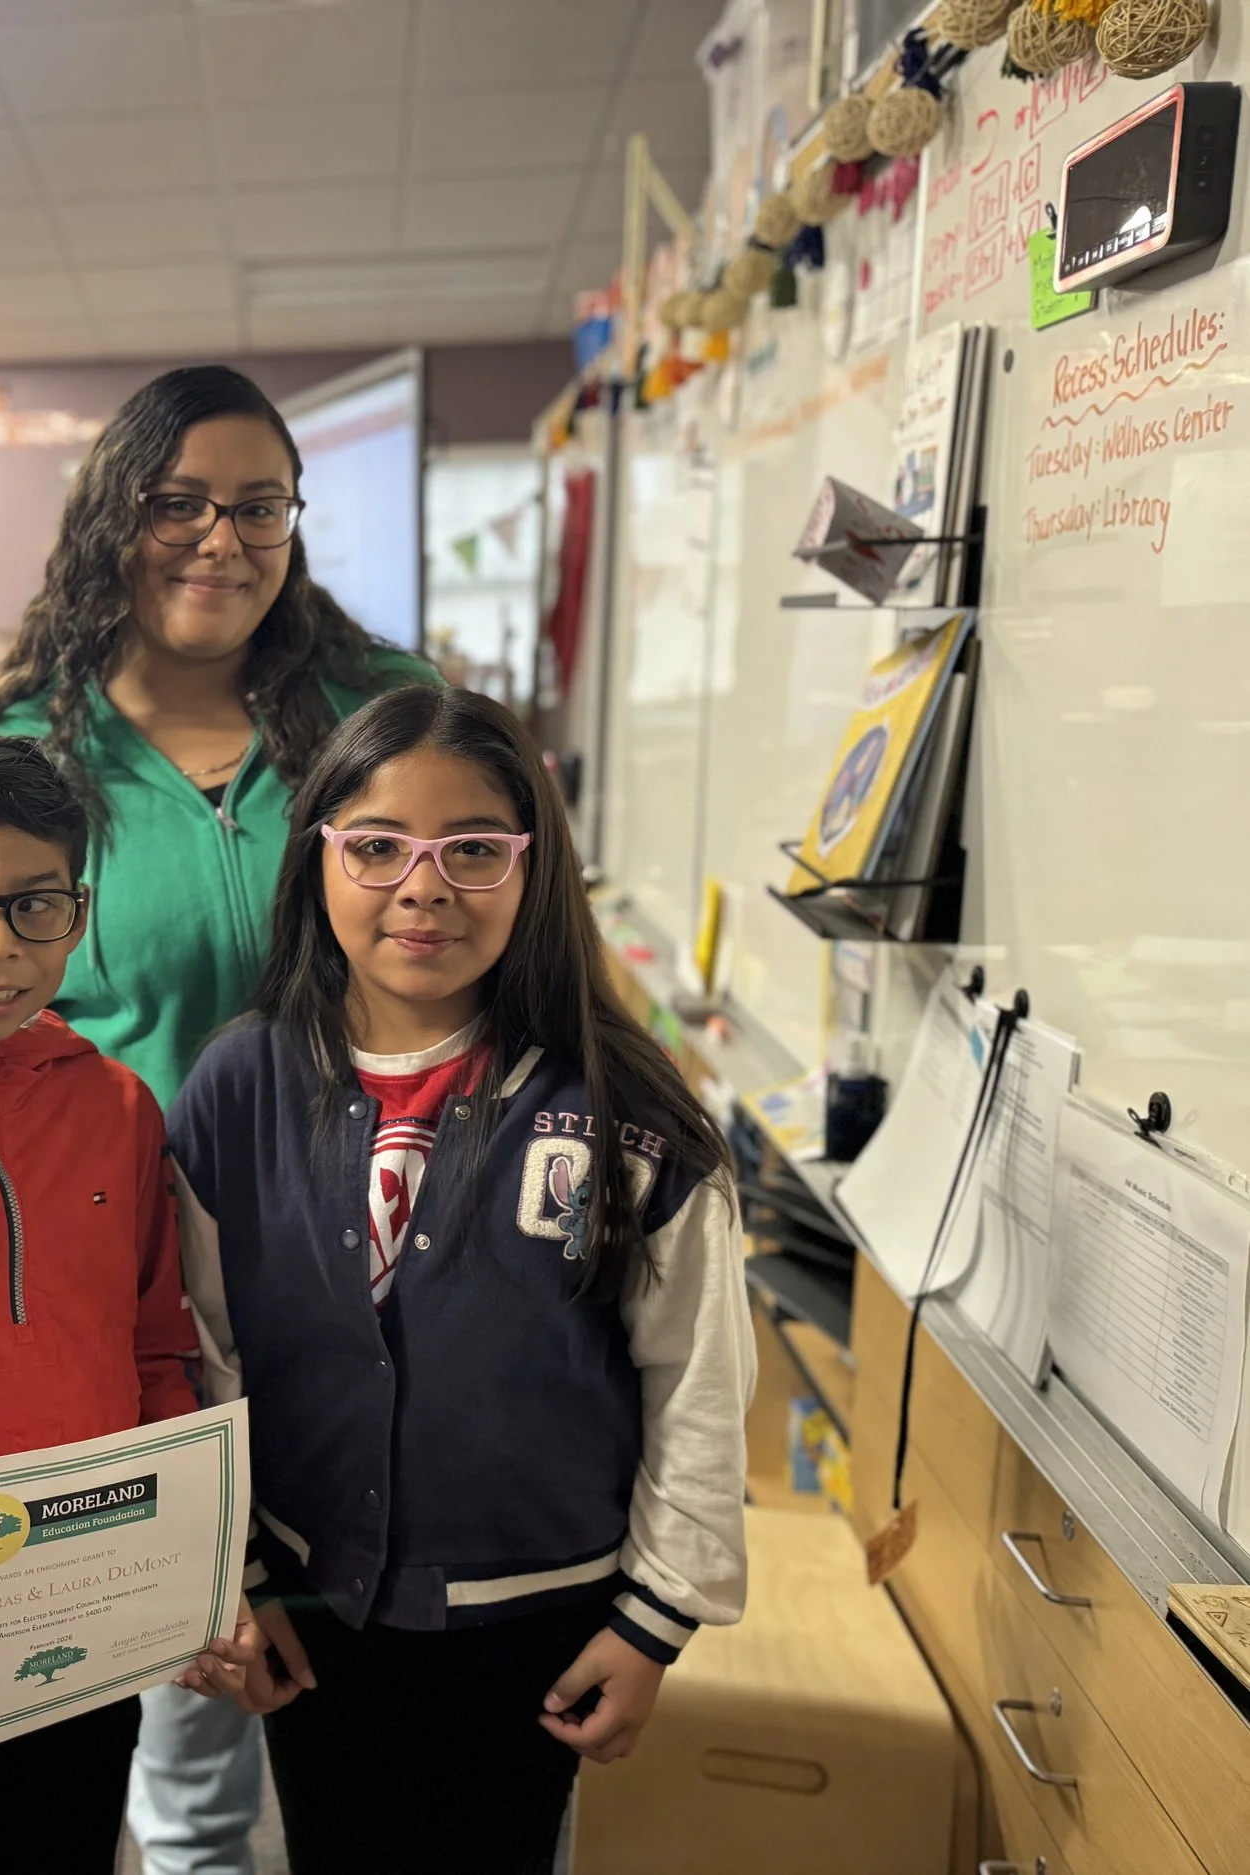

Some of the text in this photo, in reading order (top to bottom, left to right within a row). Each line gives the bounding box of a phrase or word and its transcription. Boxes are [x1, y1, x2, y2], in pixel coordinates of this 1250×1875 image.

[1053, 308, 1226, 408] Recess Schedules:
[1101, 415, 1169, 465] Wellness
[1173, 393, 1234, 443] Center
[1102, 485, 1171, 554] Library
[533, 1111, 667, 1159] STICH
[41, 1483, 146, 1520] MORELAND
[42, 1507, 146, 1538] Education Foundation
[27, 1586, 44, 1602] &
[85, 1605, 112, 1618] $400.00
[56, 1634, 73, 1644] 2026
[110, 1635, 139, 1650] Angie
[29, 1651, 74, 1669] MORELAND
